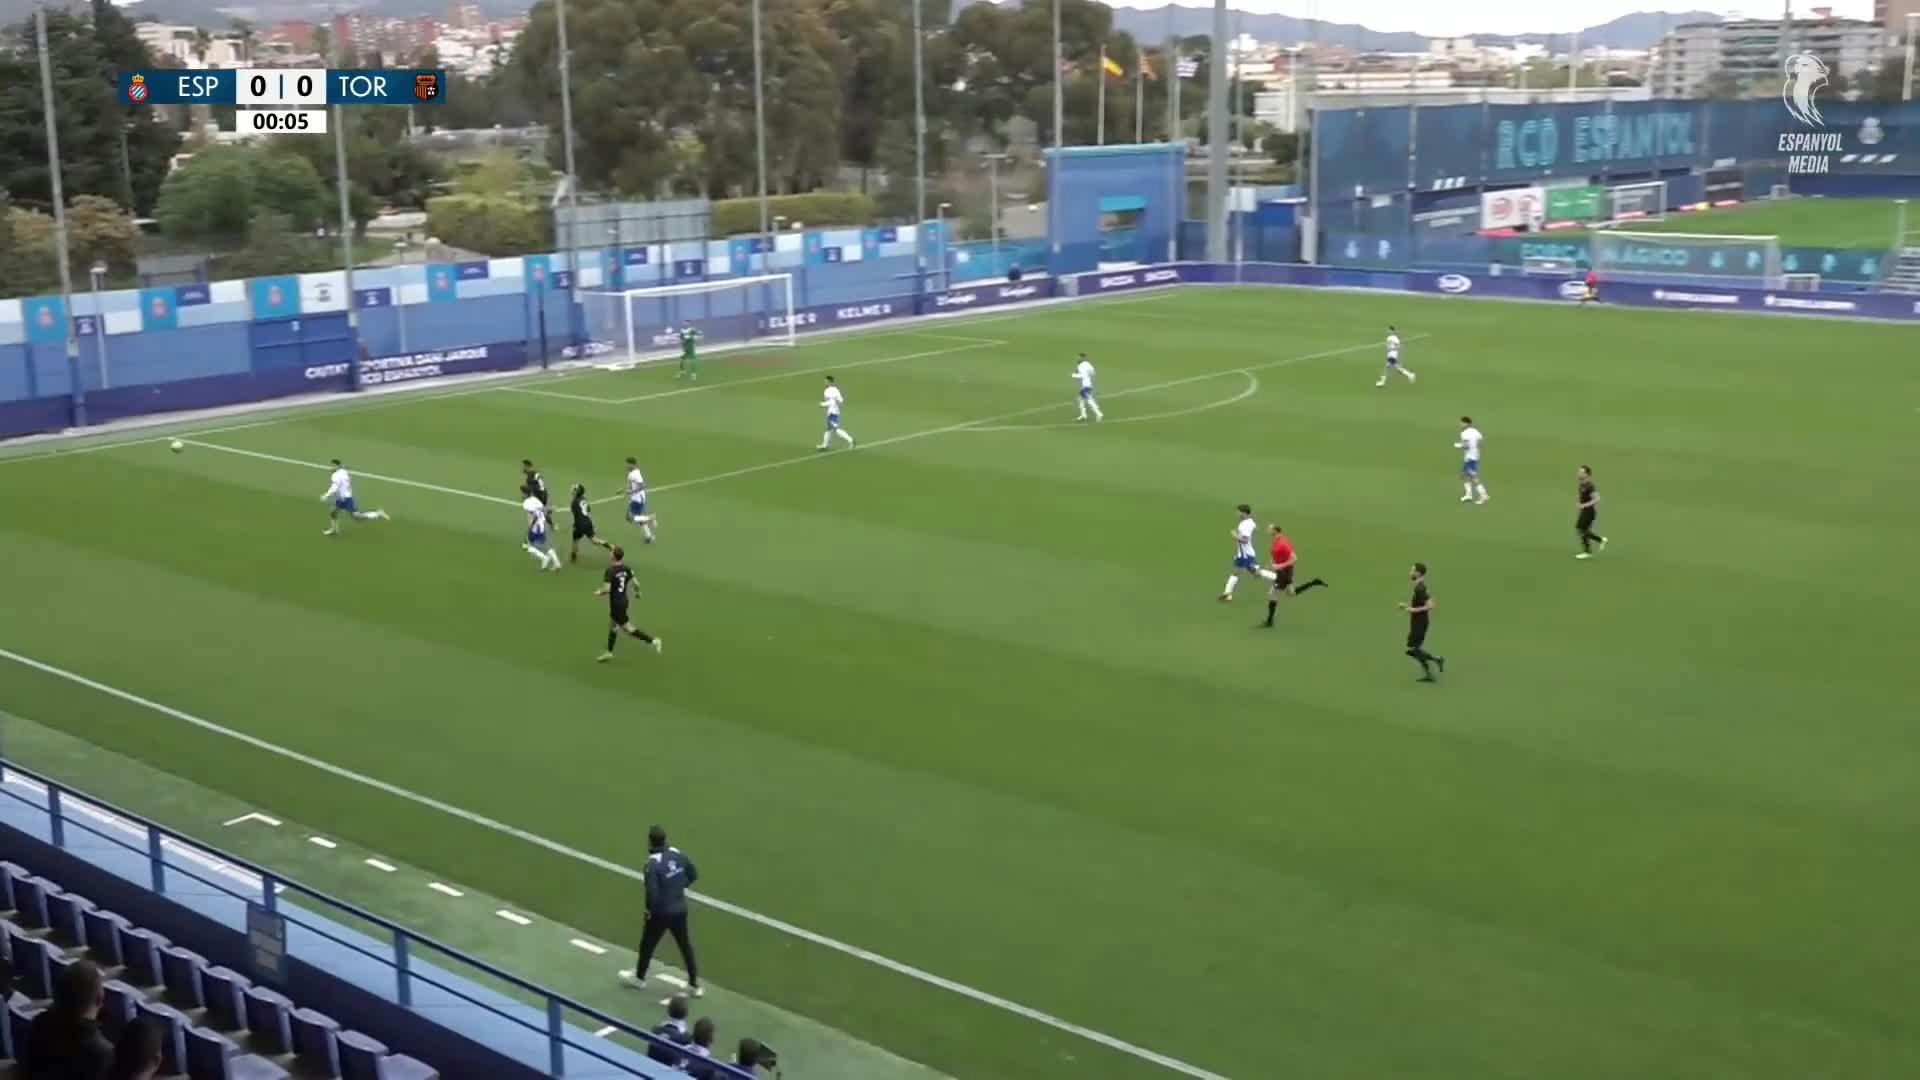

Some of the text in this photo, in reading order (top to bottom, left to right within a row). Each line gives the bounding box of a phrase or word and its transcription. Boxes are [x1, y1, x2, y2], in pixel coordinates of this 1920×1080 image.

[1496, 111, 1696, 169] RCD ESPANYOL
[617, 575, 626, 593] 3
